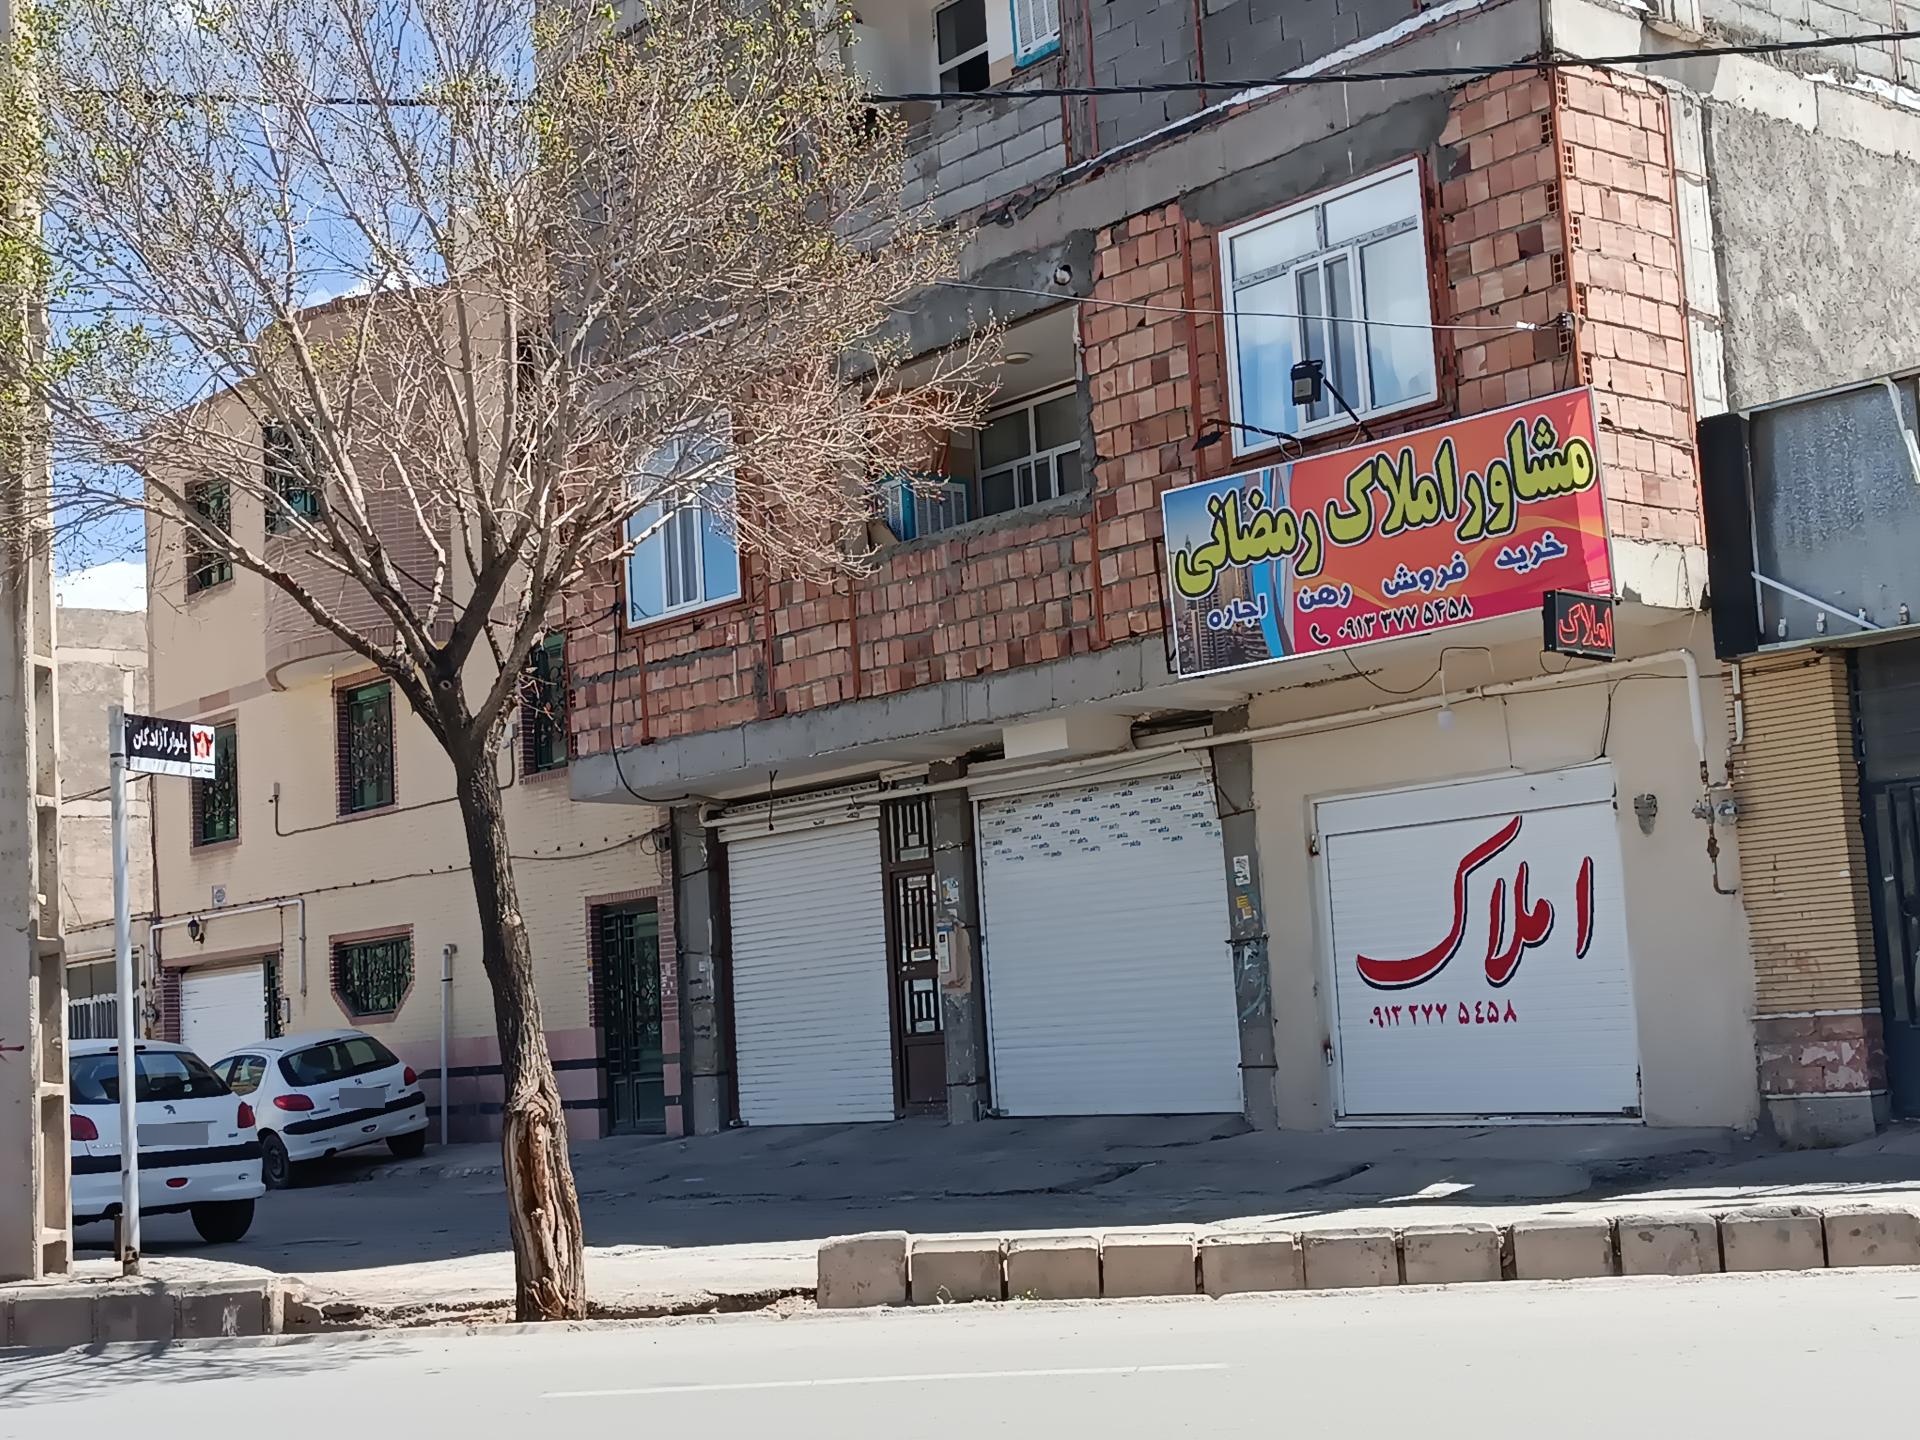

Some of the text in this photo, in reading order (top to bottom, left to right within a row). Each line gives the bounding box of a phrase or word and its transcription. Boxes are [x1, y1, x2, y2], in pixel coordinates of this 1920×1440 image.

[1175, 416, 1594, 599] مشاور املاک رمضانی
[1208, 533, 1567, 629] خرید فروش رهن اجاره
[1559, 602, 1613, 648] املاک
[133, 725, 188, 756] بلوار آزادگان
[1356, 815, 1594, 991] املاک
